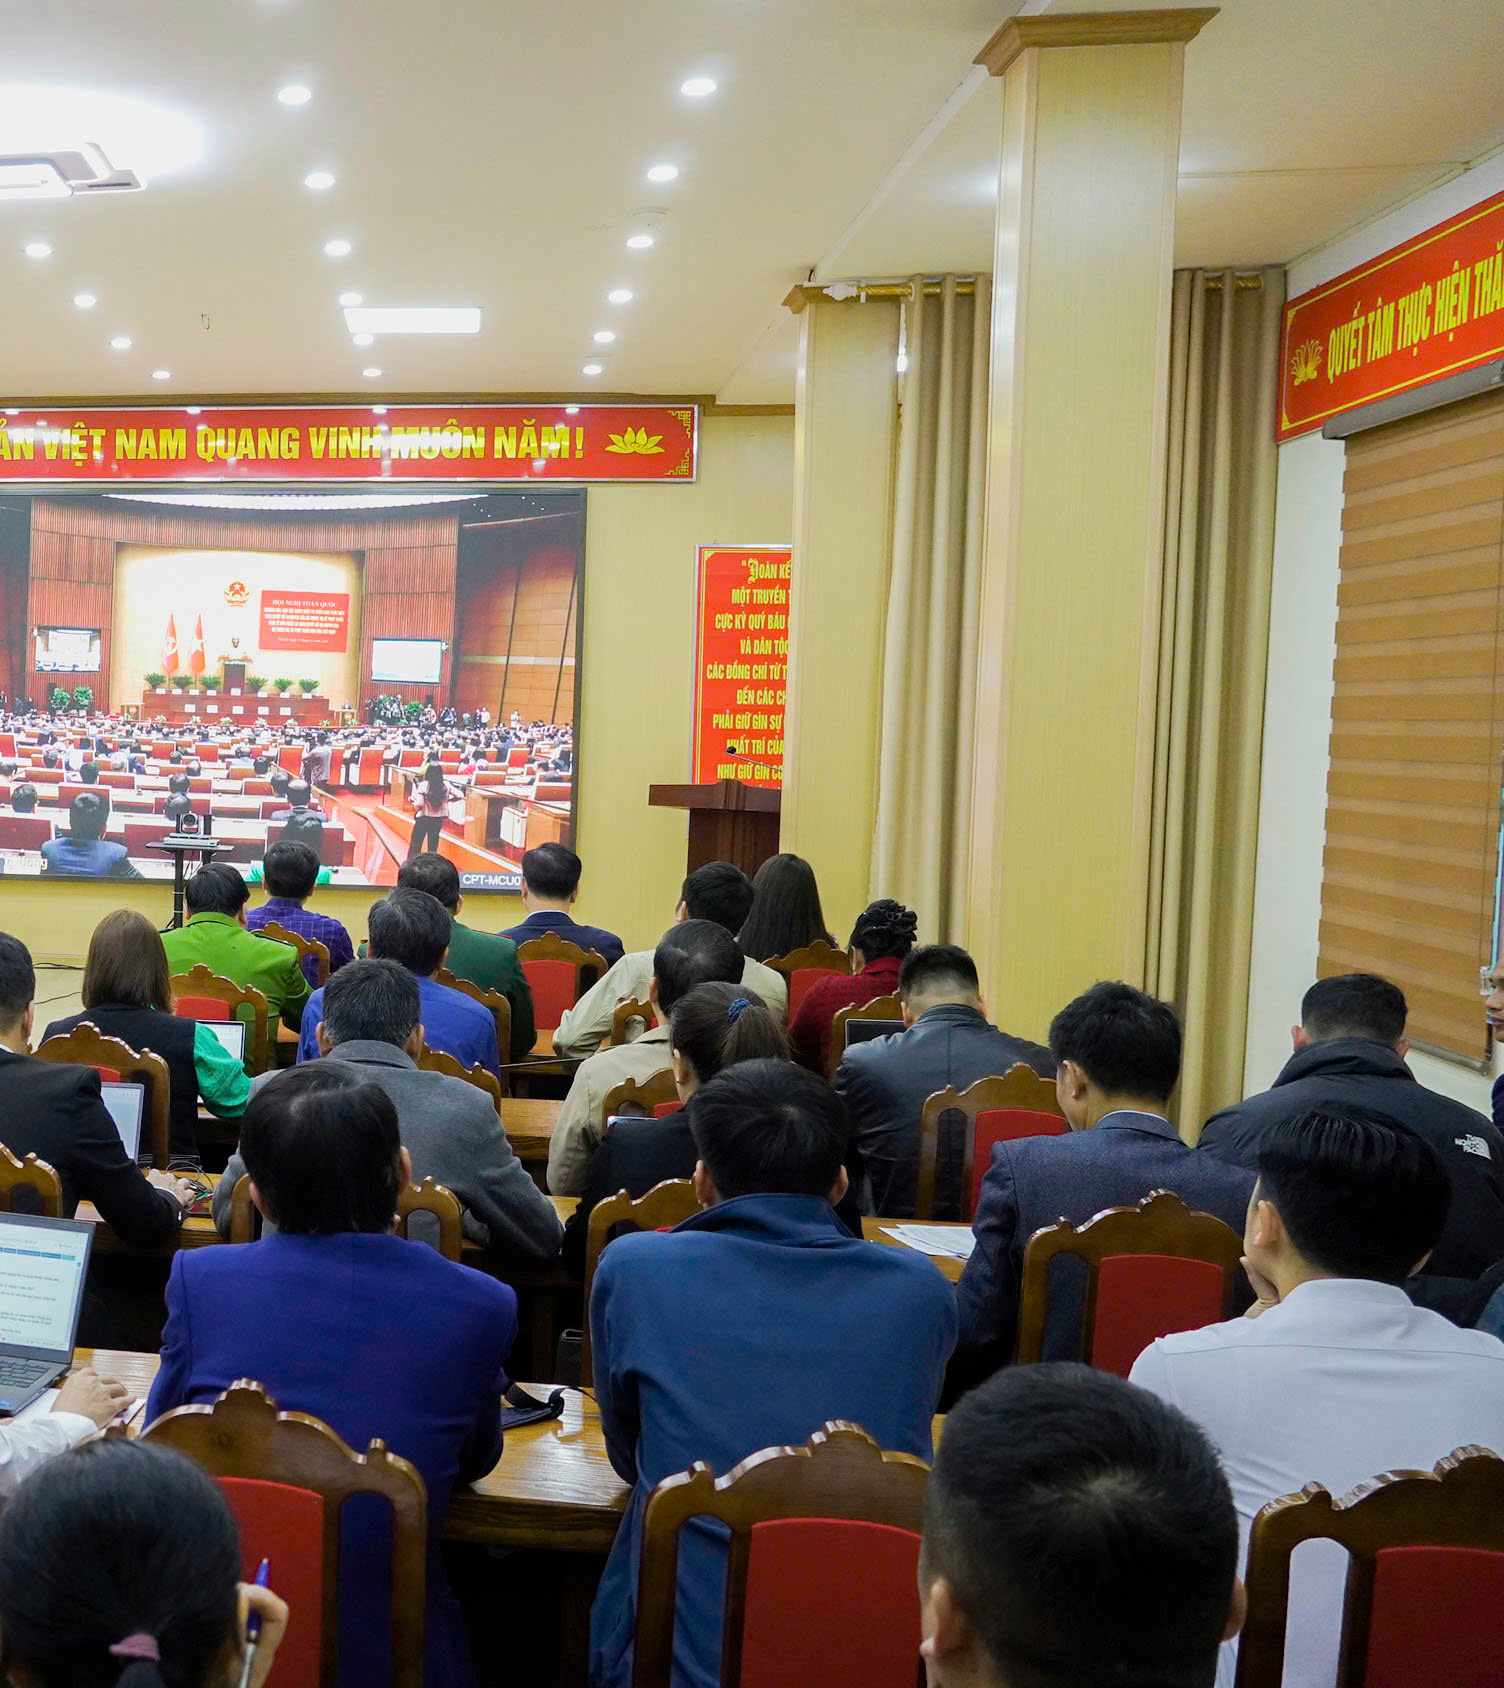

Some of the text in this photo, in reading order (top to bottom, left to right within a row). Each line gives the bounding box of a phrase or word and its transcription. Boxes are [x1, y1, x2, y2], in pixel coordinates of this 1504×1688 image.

[1327, 240, 1504, 384] QUYẾT TÂM THỰC HIỆN THẮ
[42, 421, 106, 466] VIỆT
[115, 428, 187, 460] NAM
[196, 427, 300, 463] QUANG
[308, 427, 381, 460] VINH
[390, 418, 486, 460] MUÔN
[715, 610, 786, 633] CỰC KỲ QUÝ BÁU
[740, 636, 751, 655] VÀ
[753, 636, 772, 655] DÂN
[706, 660, 724, 680] CÁC
[752, 661, 767, 680] CHÍ
[737, 685, 754, 705] ĐẾN
[757, 687, 774, 705] CÁC
[713, 709, 782, 733] PHẢI GIỮ GÌN SỰ
[752, 736, 765, 755] TRÍ
[717, 763, 736, 780] NHƯ
[738, 762, 753, 780] GIỮ
